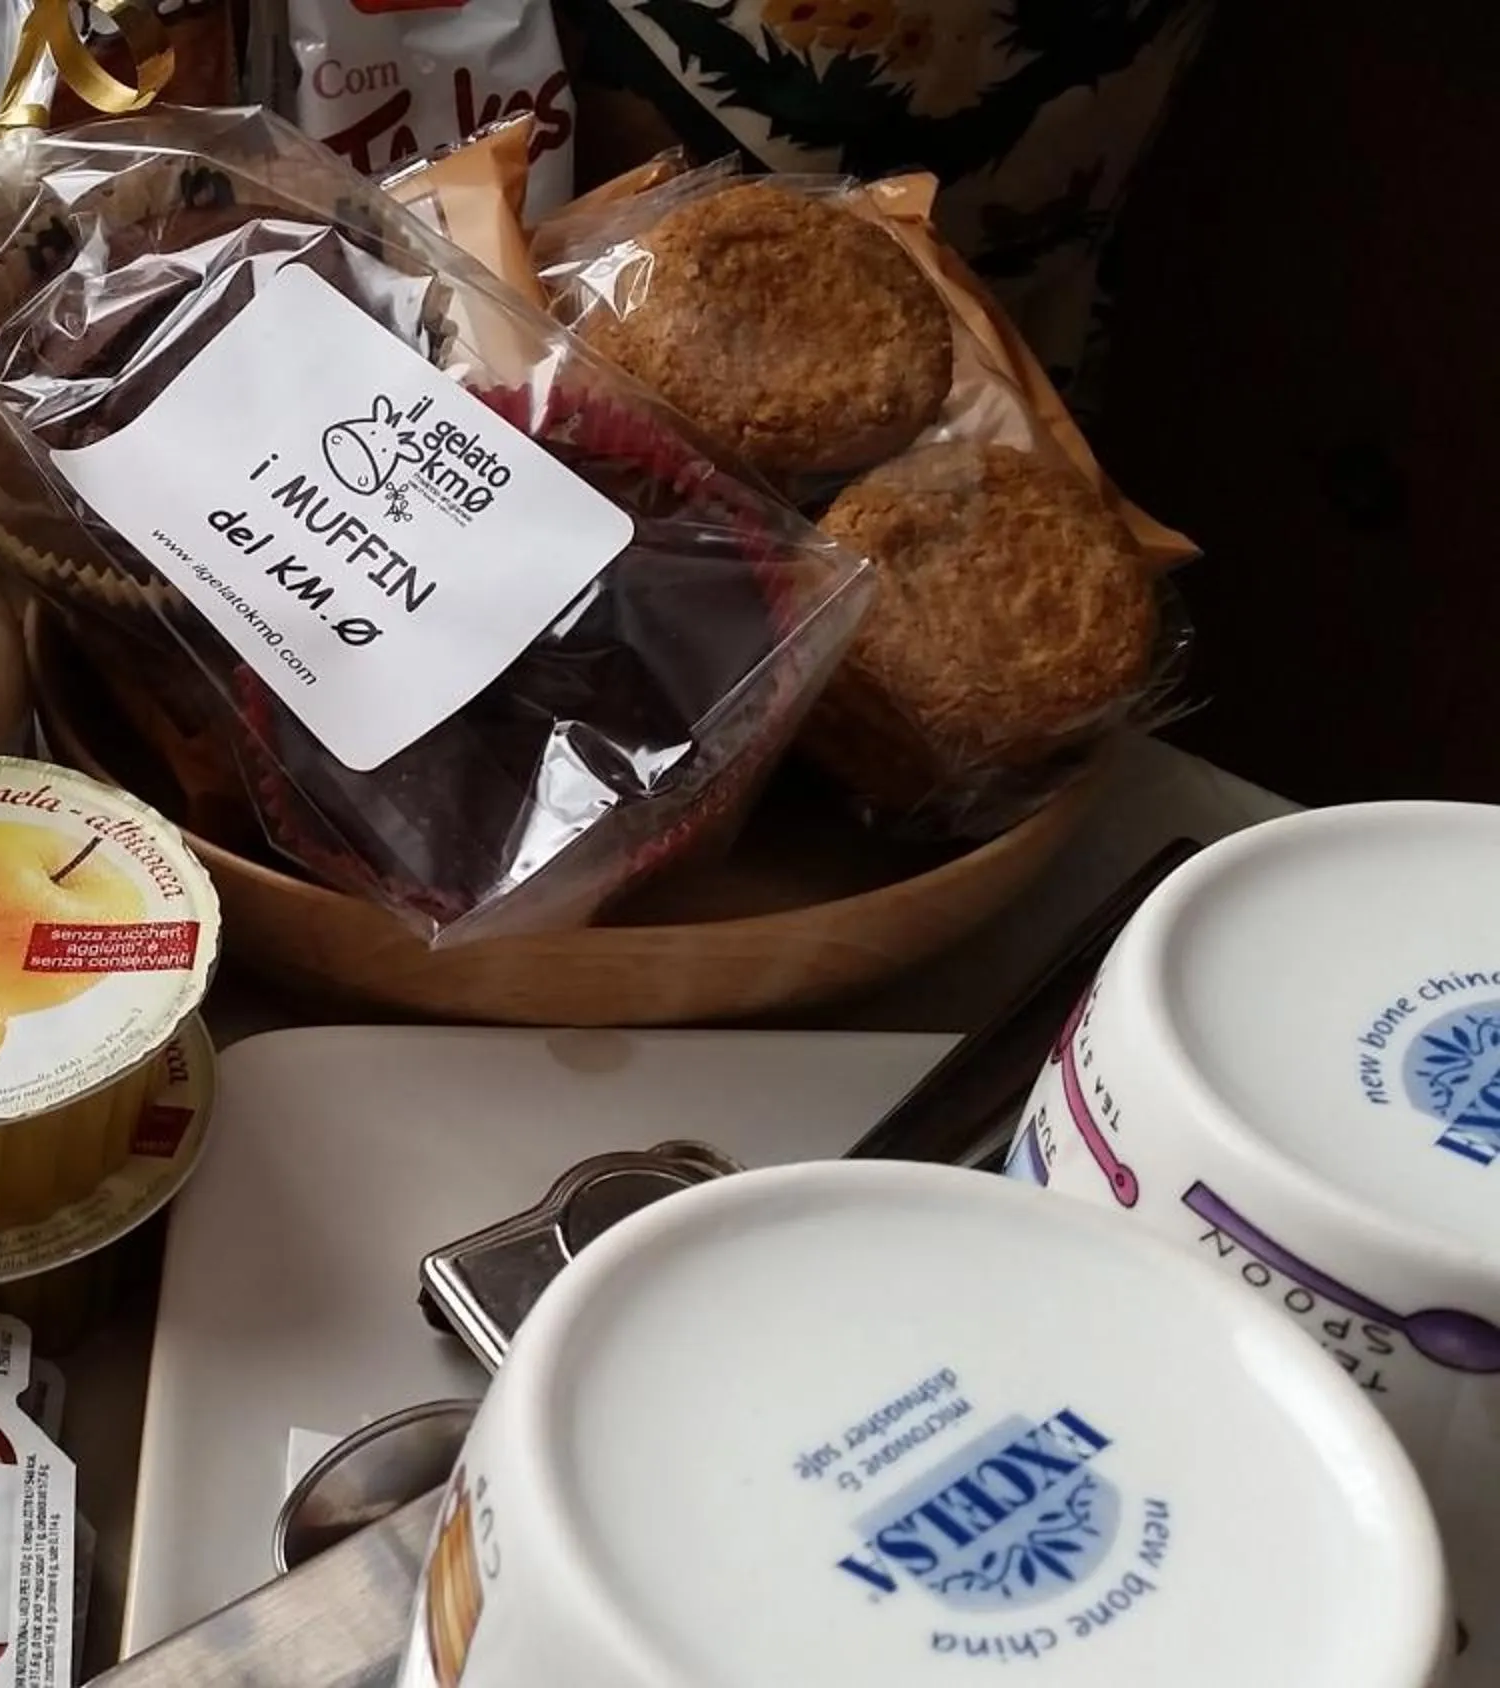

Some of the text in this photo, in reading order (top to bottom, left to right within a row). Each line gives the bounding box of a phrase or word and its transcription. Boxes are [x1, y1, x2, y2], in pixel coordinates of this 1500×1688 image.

[312, 60, 399, 98] Corn
[406, 396, 434, 423] il
[423, 421, 511, 487] gelato
[207, 509, 274, 555] del
[250, 453, 279, 480] i
[271, 475, 437, 614] MUFFIN
[85, 814, 186, 900] albicocca
[30, 952, 190, 968] senza conservanti
[51, 929, 102, 941] senza
[1357, 997, 1418, 1050] bone
[1360, 1053, 1391, 1105] new
[1199, 1228, 1395, 1356] SPOON
[1322, 1342, 1389, 1394] TE
[793, 1367, 957, 1481] dishwasher safe
[867, 1397, 973, 1477] microwave
[836, 1407, 1114, 1594] EXCELSA
[930, 1496, 1171, 1662] new bone china
